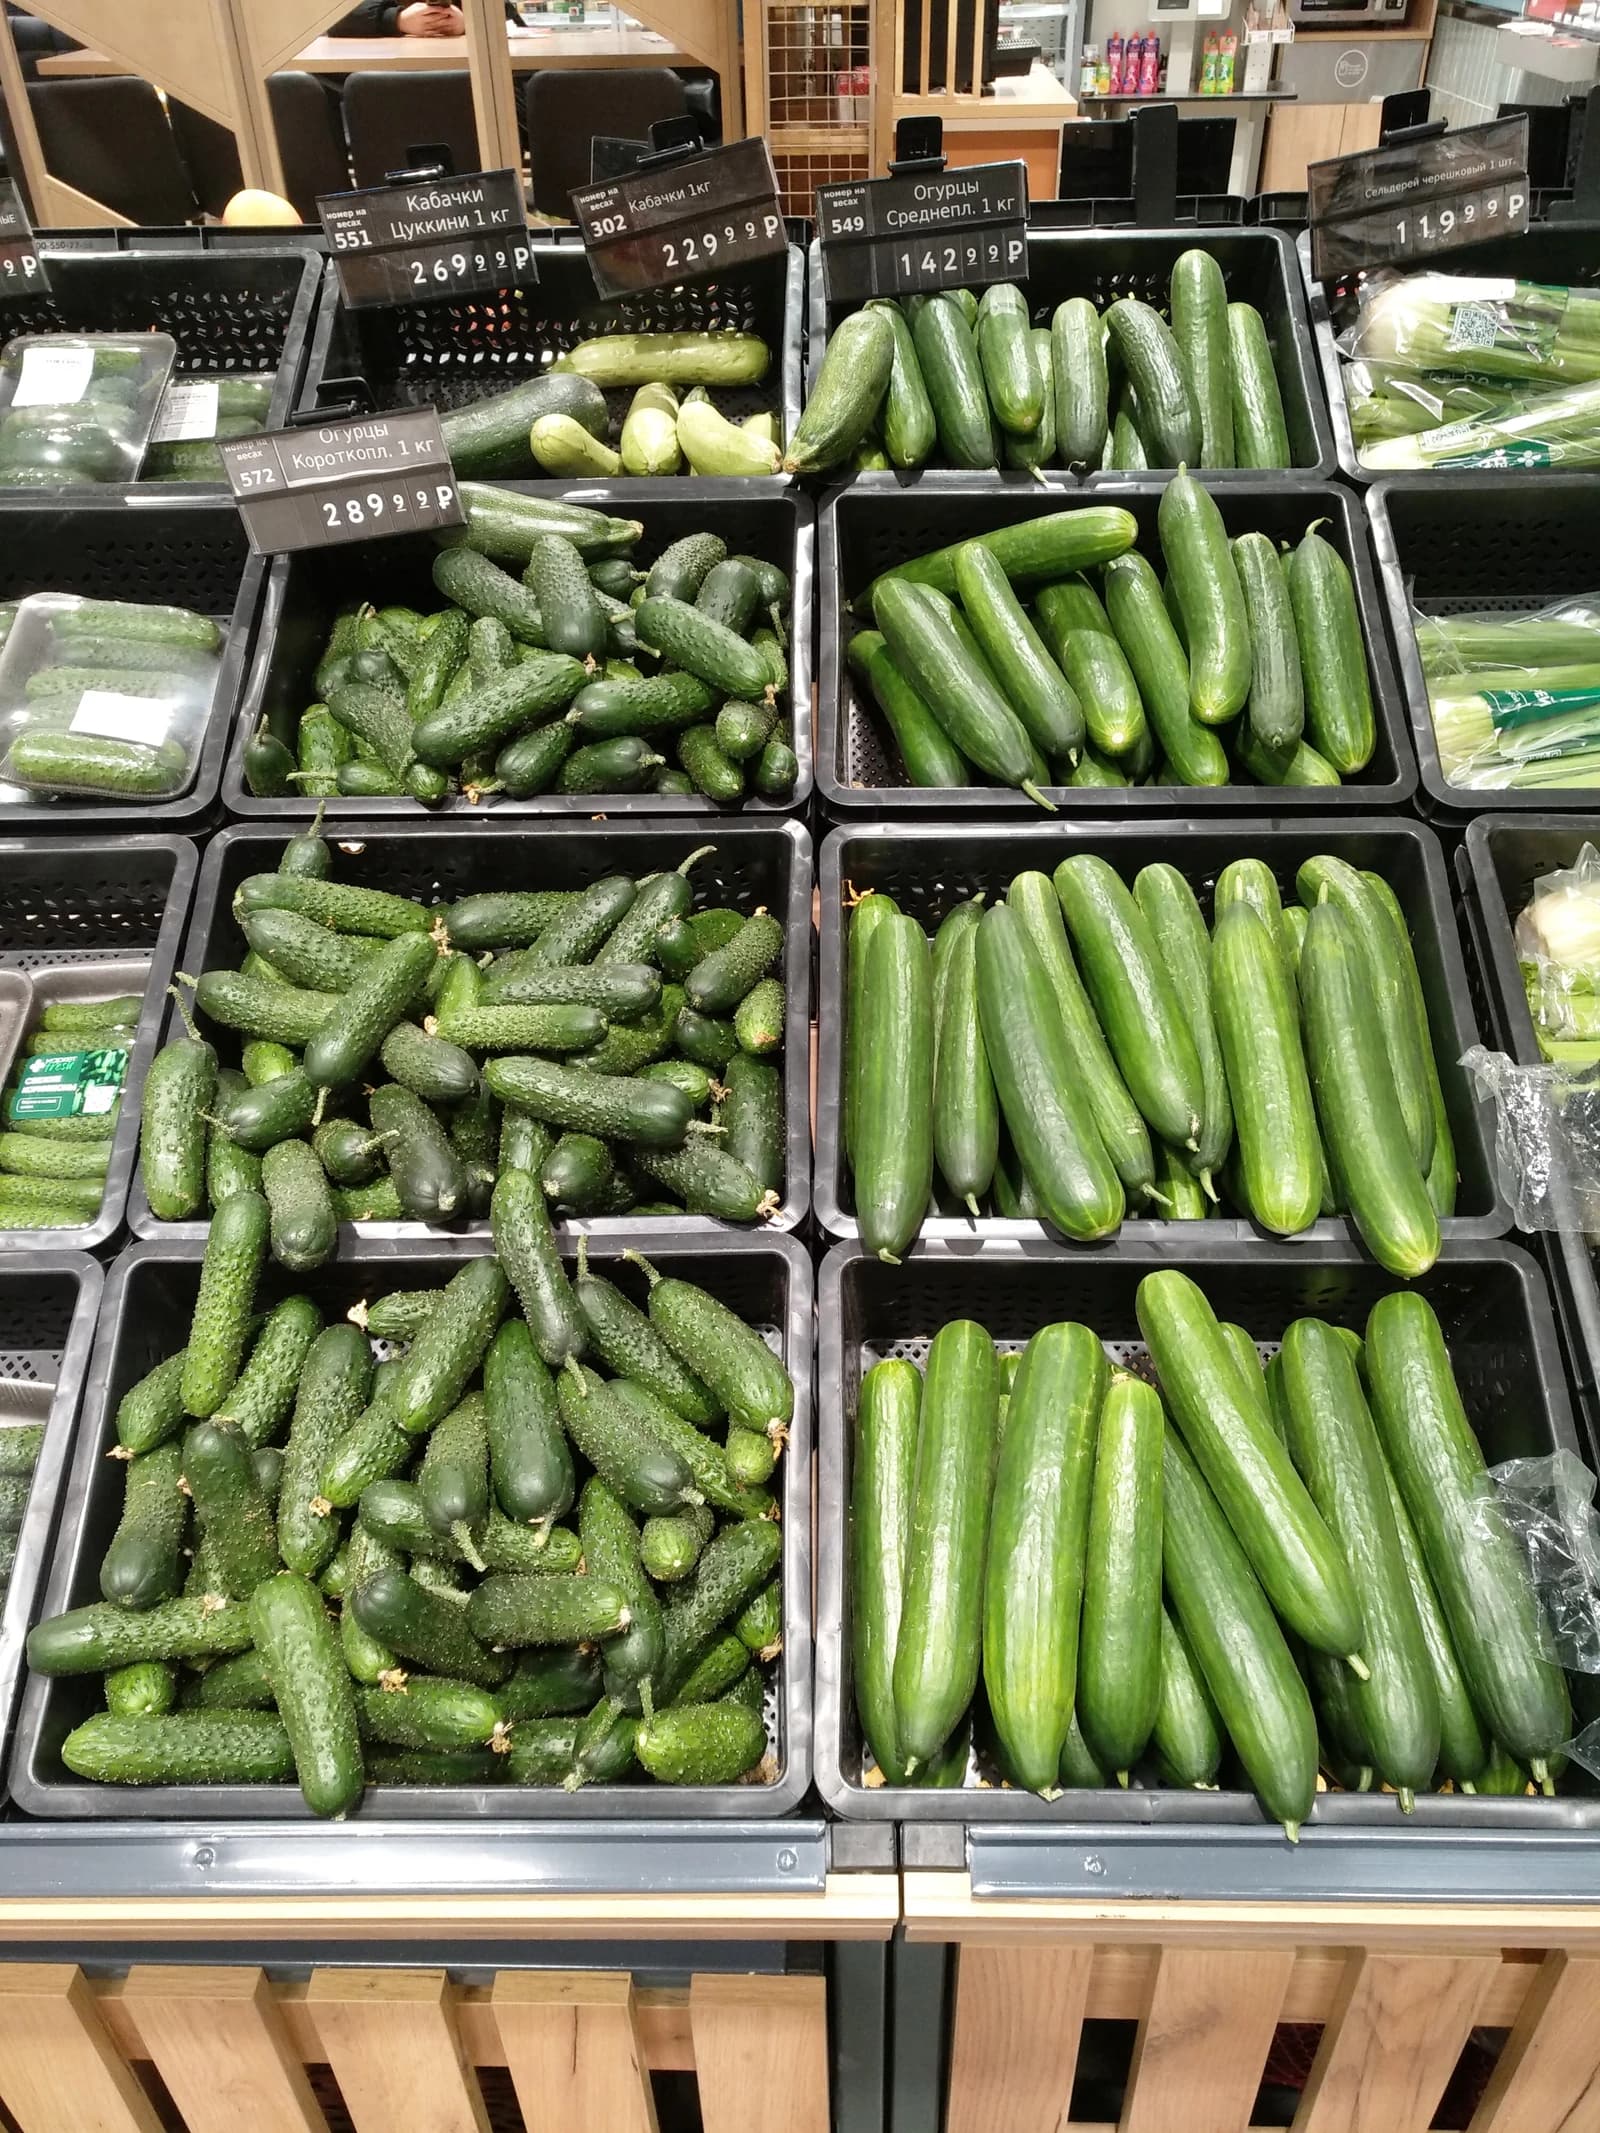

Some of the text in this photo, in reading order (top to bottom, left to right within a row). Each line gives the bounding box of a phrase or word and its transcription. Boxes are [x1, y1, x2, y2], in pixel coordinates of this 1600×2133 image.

[1364, 177, 1420, 199] Сельдерей
[1490, 160, 1496, 170] 1
[1498, 157, 1517, 169] шт.
[405, 188, 485, 213] Кабачки
[579, 186, 619, 204] номер на
[628, 189, 686, 214] Кабачки
[823, 186, 866, 200] номер на
[913, 180, 980, 202] Огурцы
[589, 198, 615, 212] весах
[832, 197, 859, 208] весах
[886, 197, 1015, 228] Среднепл. 1 кг
[326, 207, 367, 221] номер на
[336, 218, 362, 229] весах
[390, 208, 510, 241] Цуккини 1 кг
[590, 213, 627, 238] 302
[831, 215, 865, 235] 549
[334, 229, 373, 250] 551
[318, 423, 390, 446] Огурцы
[236, 450, 263, 461] весах
[291, 438, 435, 471] Короткопл. 1 кг
[239, 468, 277, 488] 572
